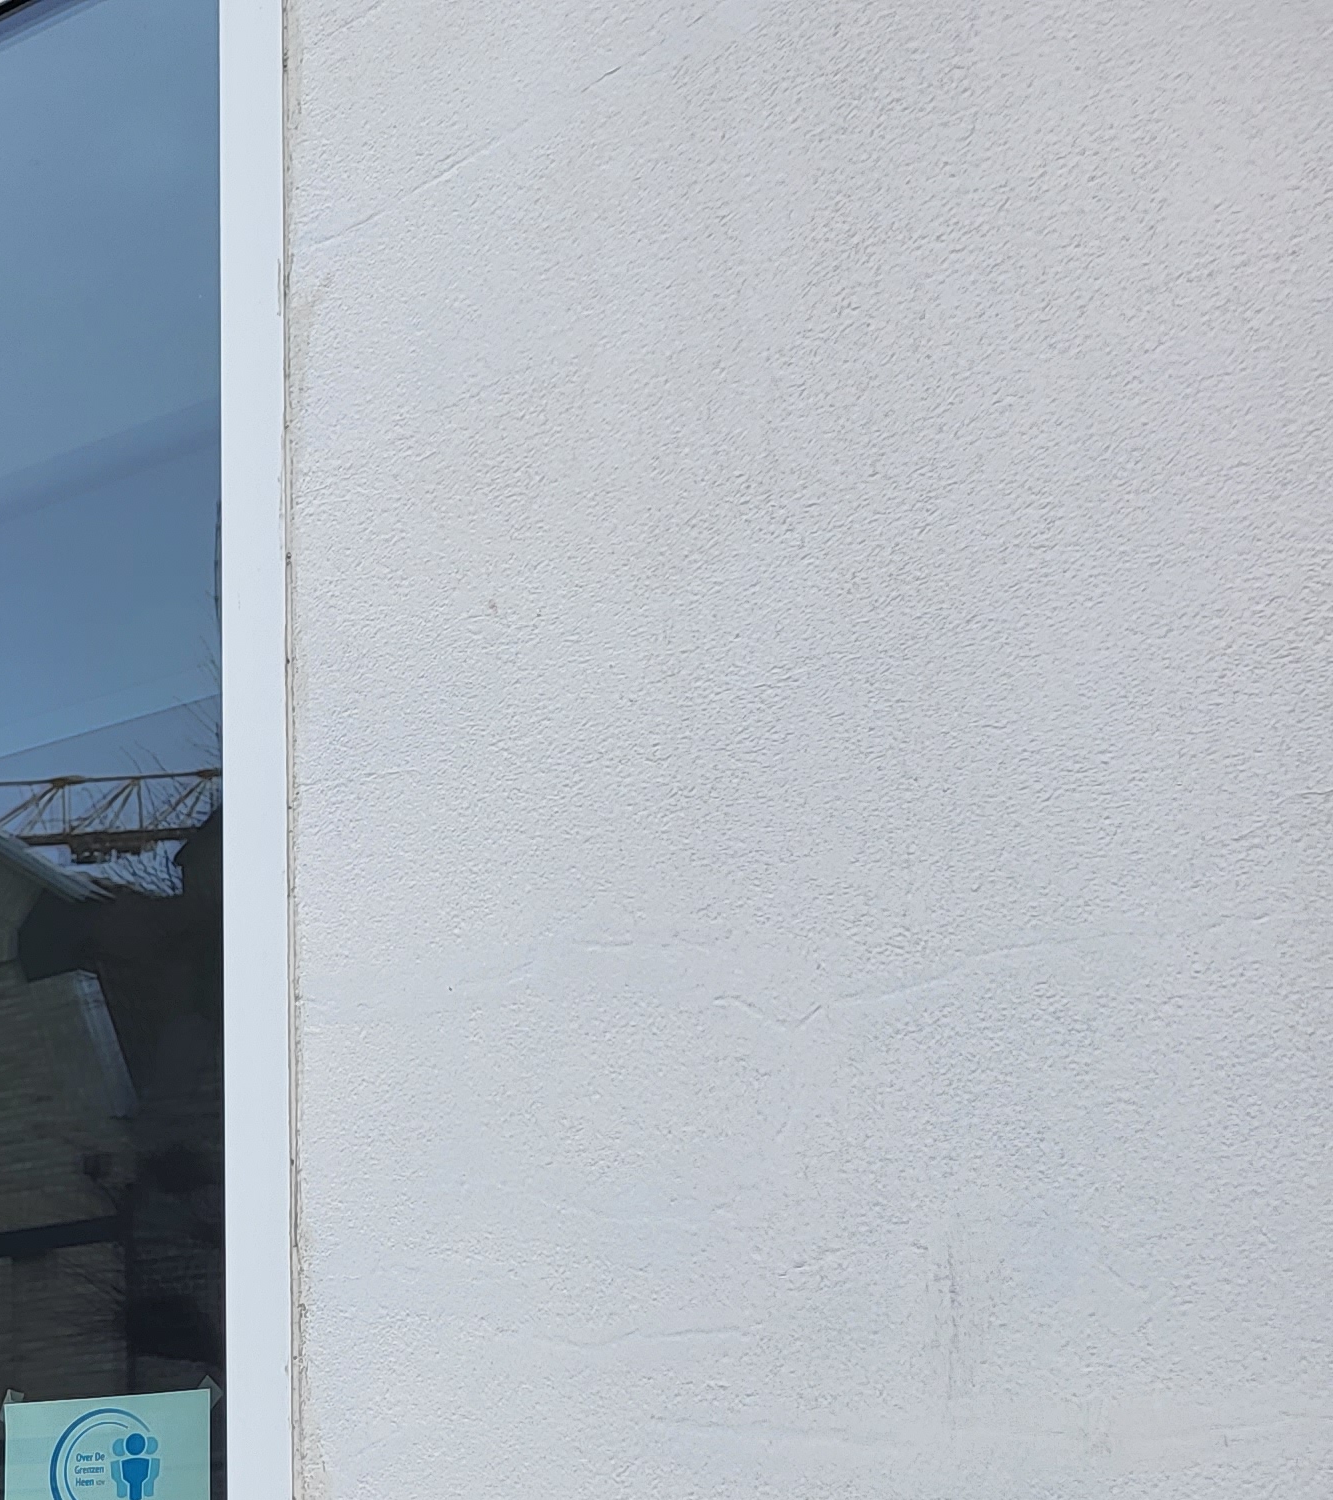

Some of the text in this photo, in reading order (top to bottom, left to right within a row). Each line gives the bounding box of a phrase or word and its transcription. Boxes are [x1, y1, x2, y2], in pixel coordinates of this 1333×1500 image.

[76, 1452, 105, 1462] Over De
[75, 1466, 104, 1474] Grenzen
[75, 1478, 94, 1486] Heen
